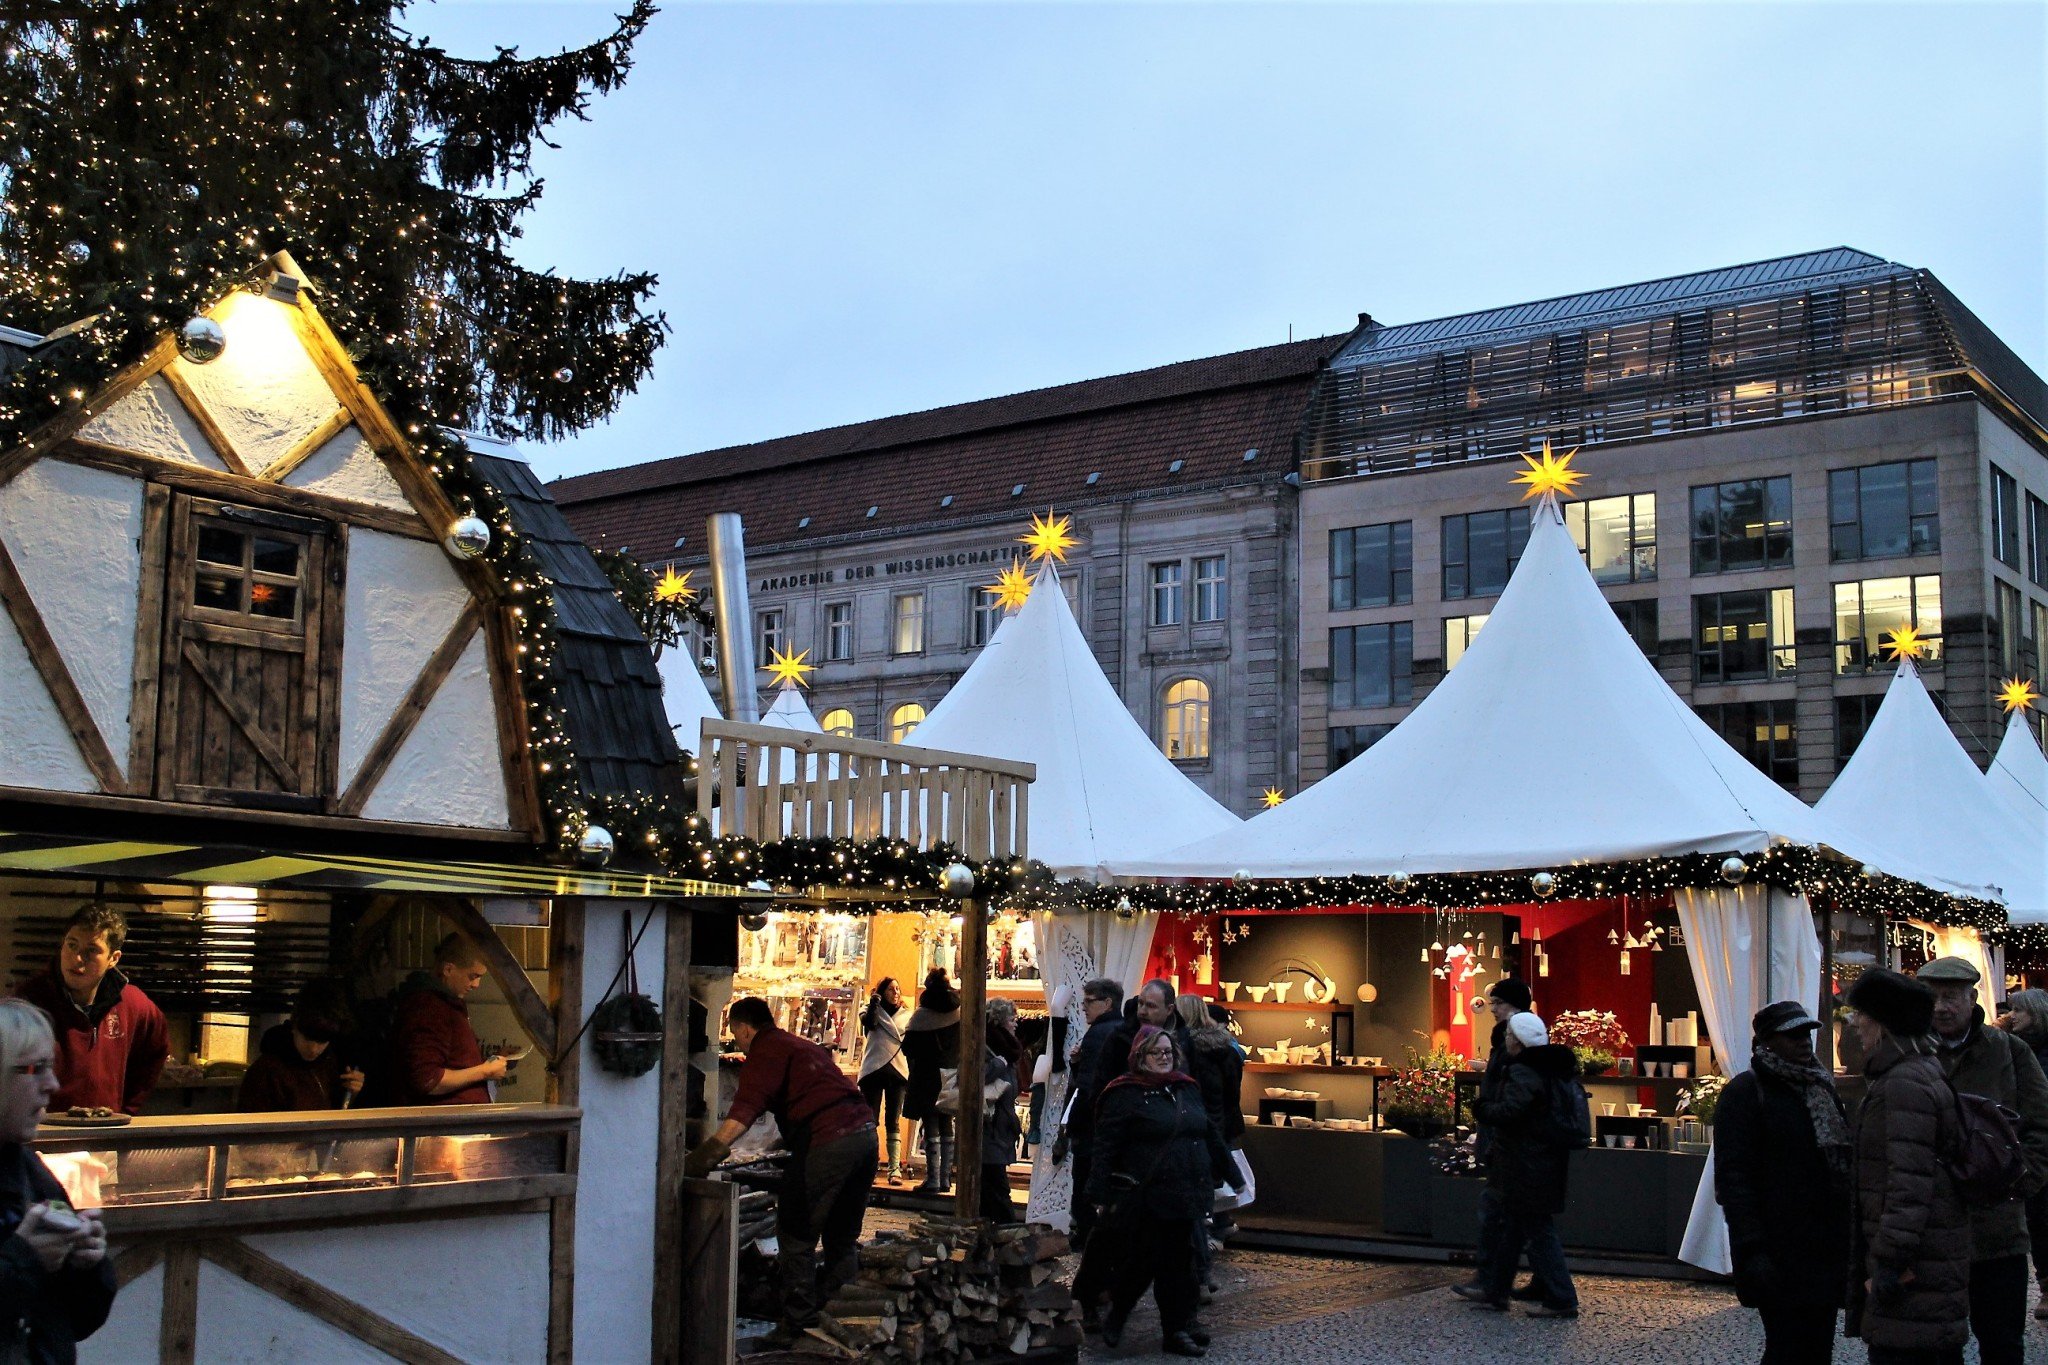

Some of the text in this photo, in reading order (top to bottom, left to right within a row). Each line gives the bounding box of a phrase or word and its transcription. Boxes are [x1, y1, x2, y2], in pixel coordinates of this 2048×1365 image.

[760, 544, 1032, 591] AKADEMIE DER WISSENSCHAFTEN
